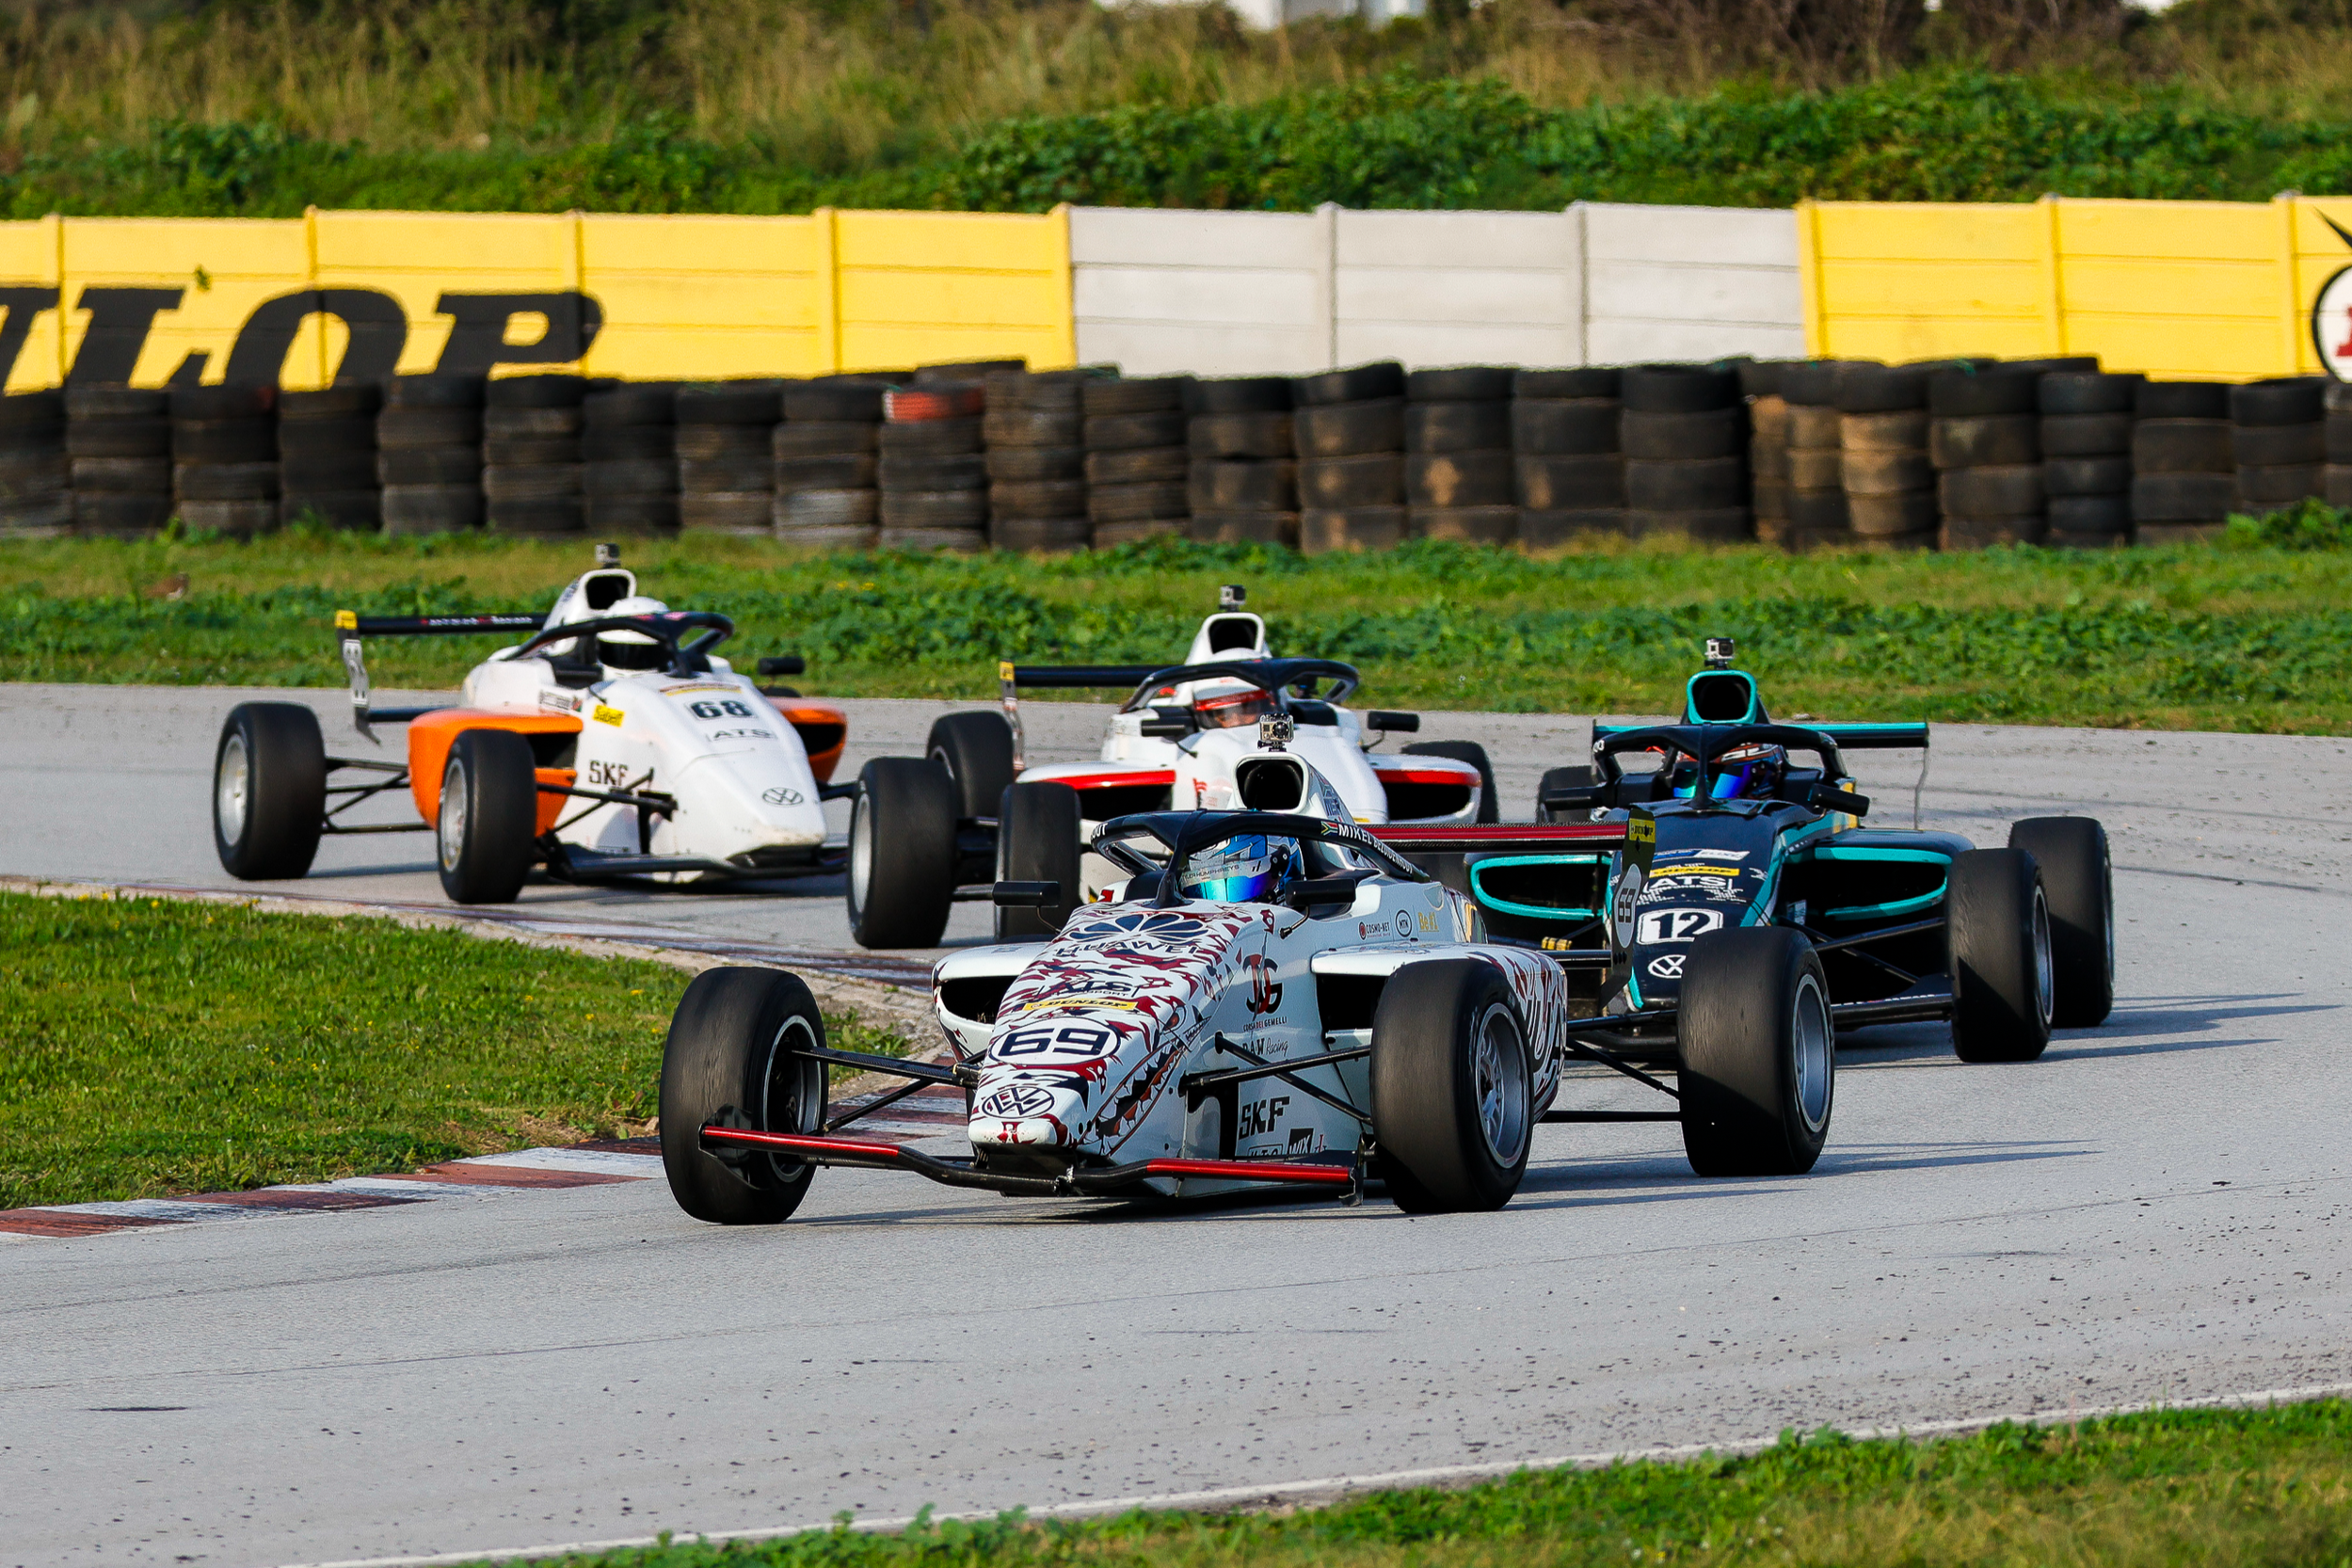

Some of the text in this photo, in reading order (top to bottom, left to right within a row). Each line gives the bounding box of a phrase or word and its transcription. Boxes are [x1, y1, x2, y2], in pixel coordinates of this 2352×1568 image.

[691, 700, 753, 718] 68
[713, 728, 773, 740] ATS
[589, 760, 629, 786] SKF
[1337, 824, 1372, 845] MIKEL
[1649, 876, 1727, 889] ATS
[1651, 911, 1711, 939] 12
[1055, 941, 1199, 957] HUAWEI
[1043, 999, 1128, 1009] DUNLOP
[998, 1028, 1111, 1056] 69
[1239, 1096, 1290, 1141] SKF
[1288, 1134, 1312, 1155] WIX
